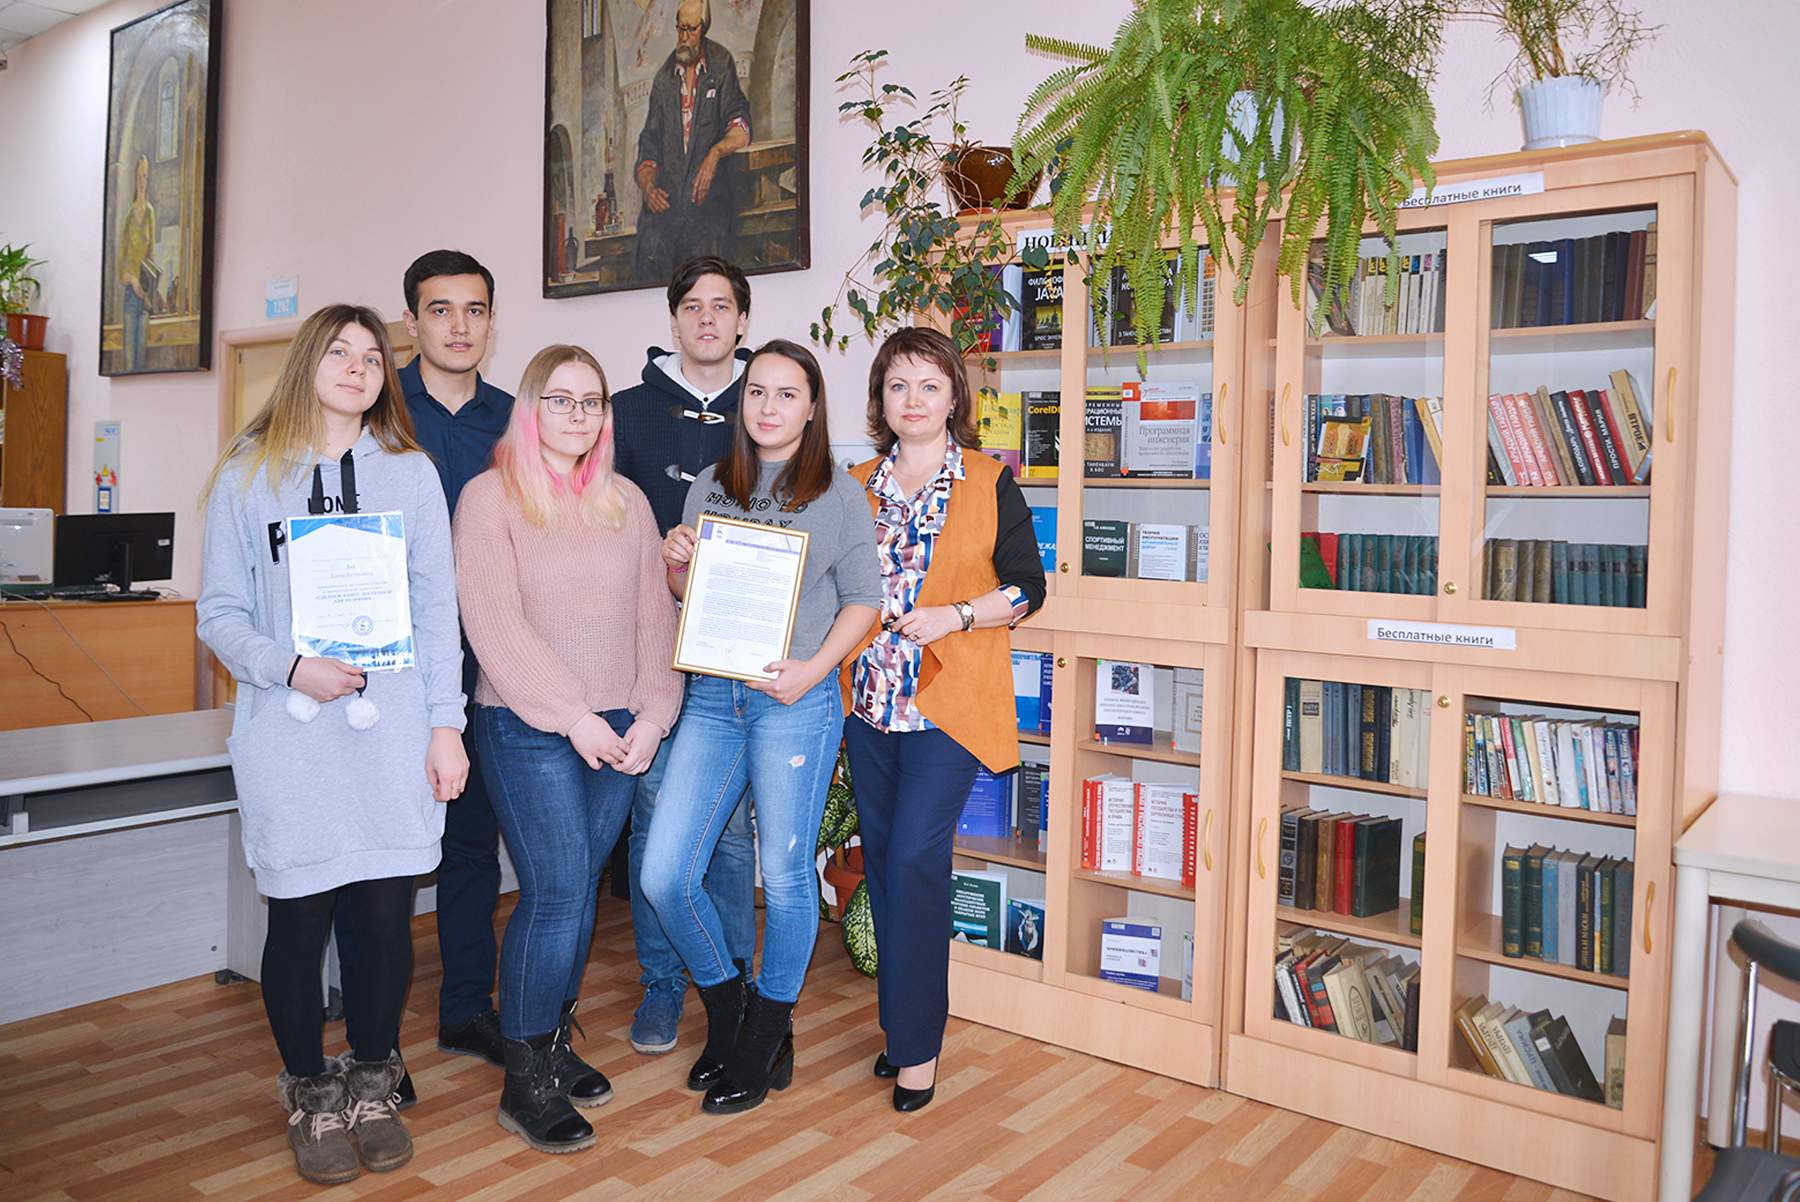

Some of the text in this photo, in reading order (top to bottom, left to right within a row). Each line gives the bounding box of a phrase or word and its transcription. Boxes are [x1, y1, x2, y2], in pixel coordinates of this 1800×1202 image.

[1402, 183, 1521, 207] Бесплатные книги
[1139, 426, 1190, 437] Программная
[1595, 408, 1609, 436] МАРИЯ
[1147, 436, 1190, 446] инженерия
[307, 493, 361, 514] ON
[1377, 626, 1494, 645] Бесплатные книги
